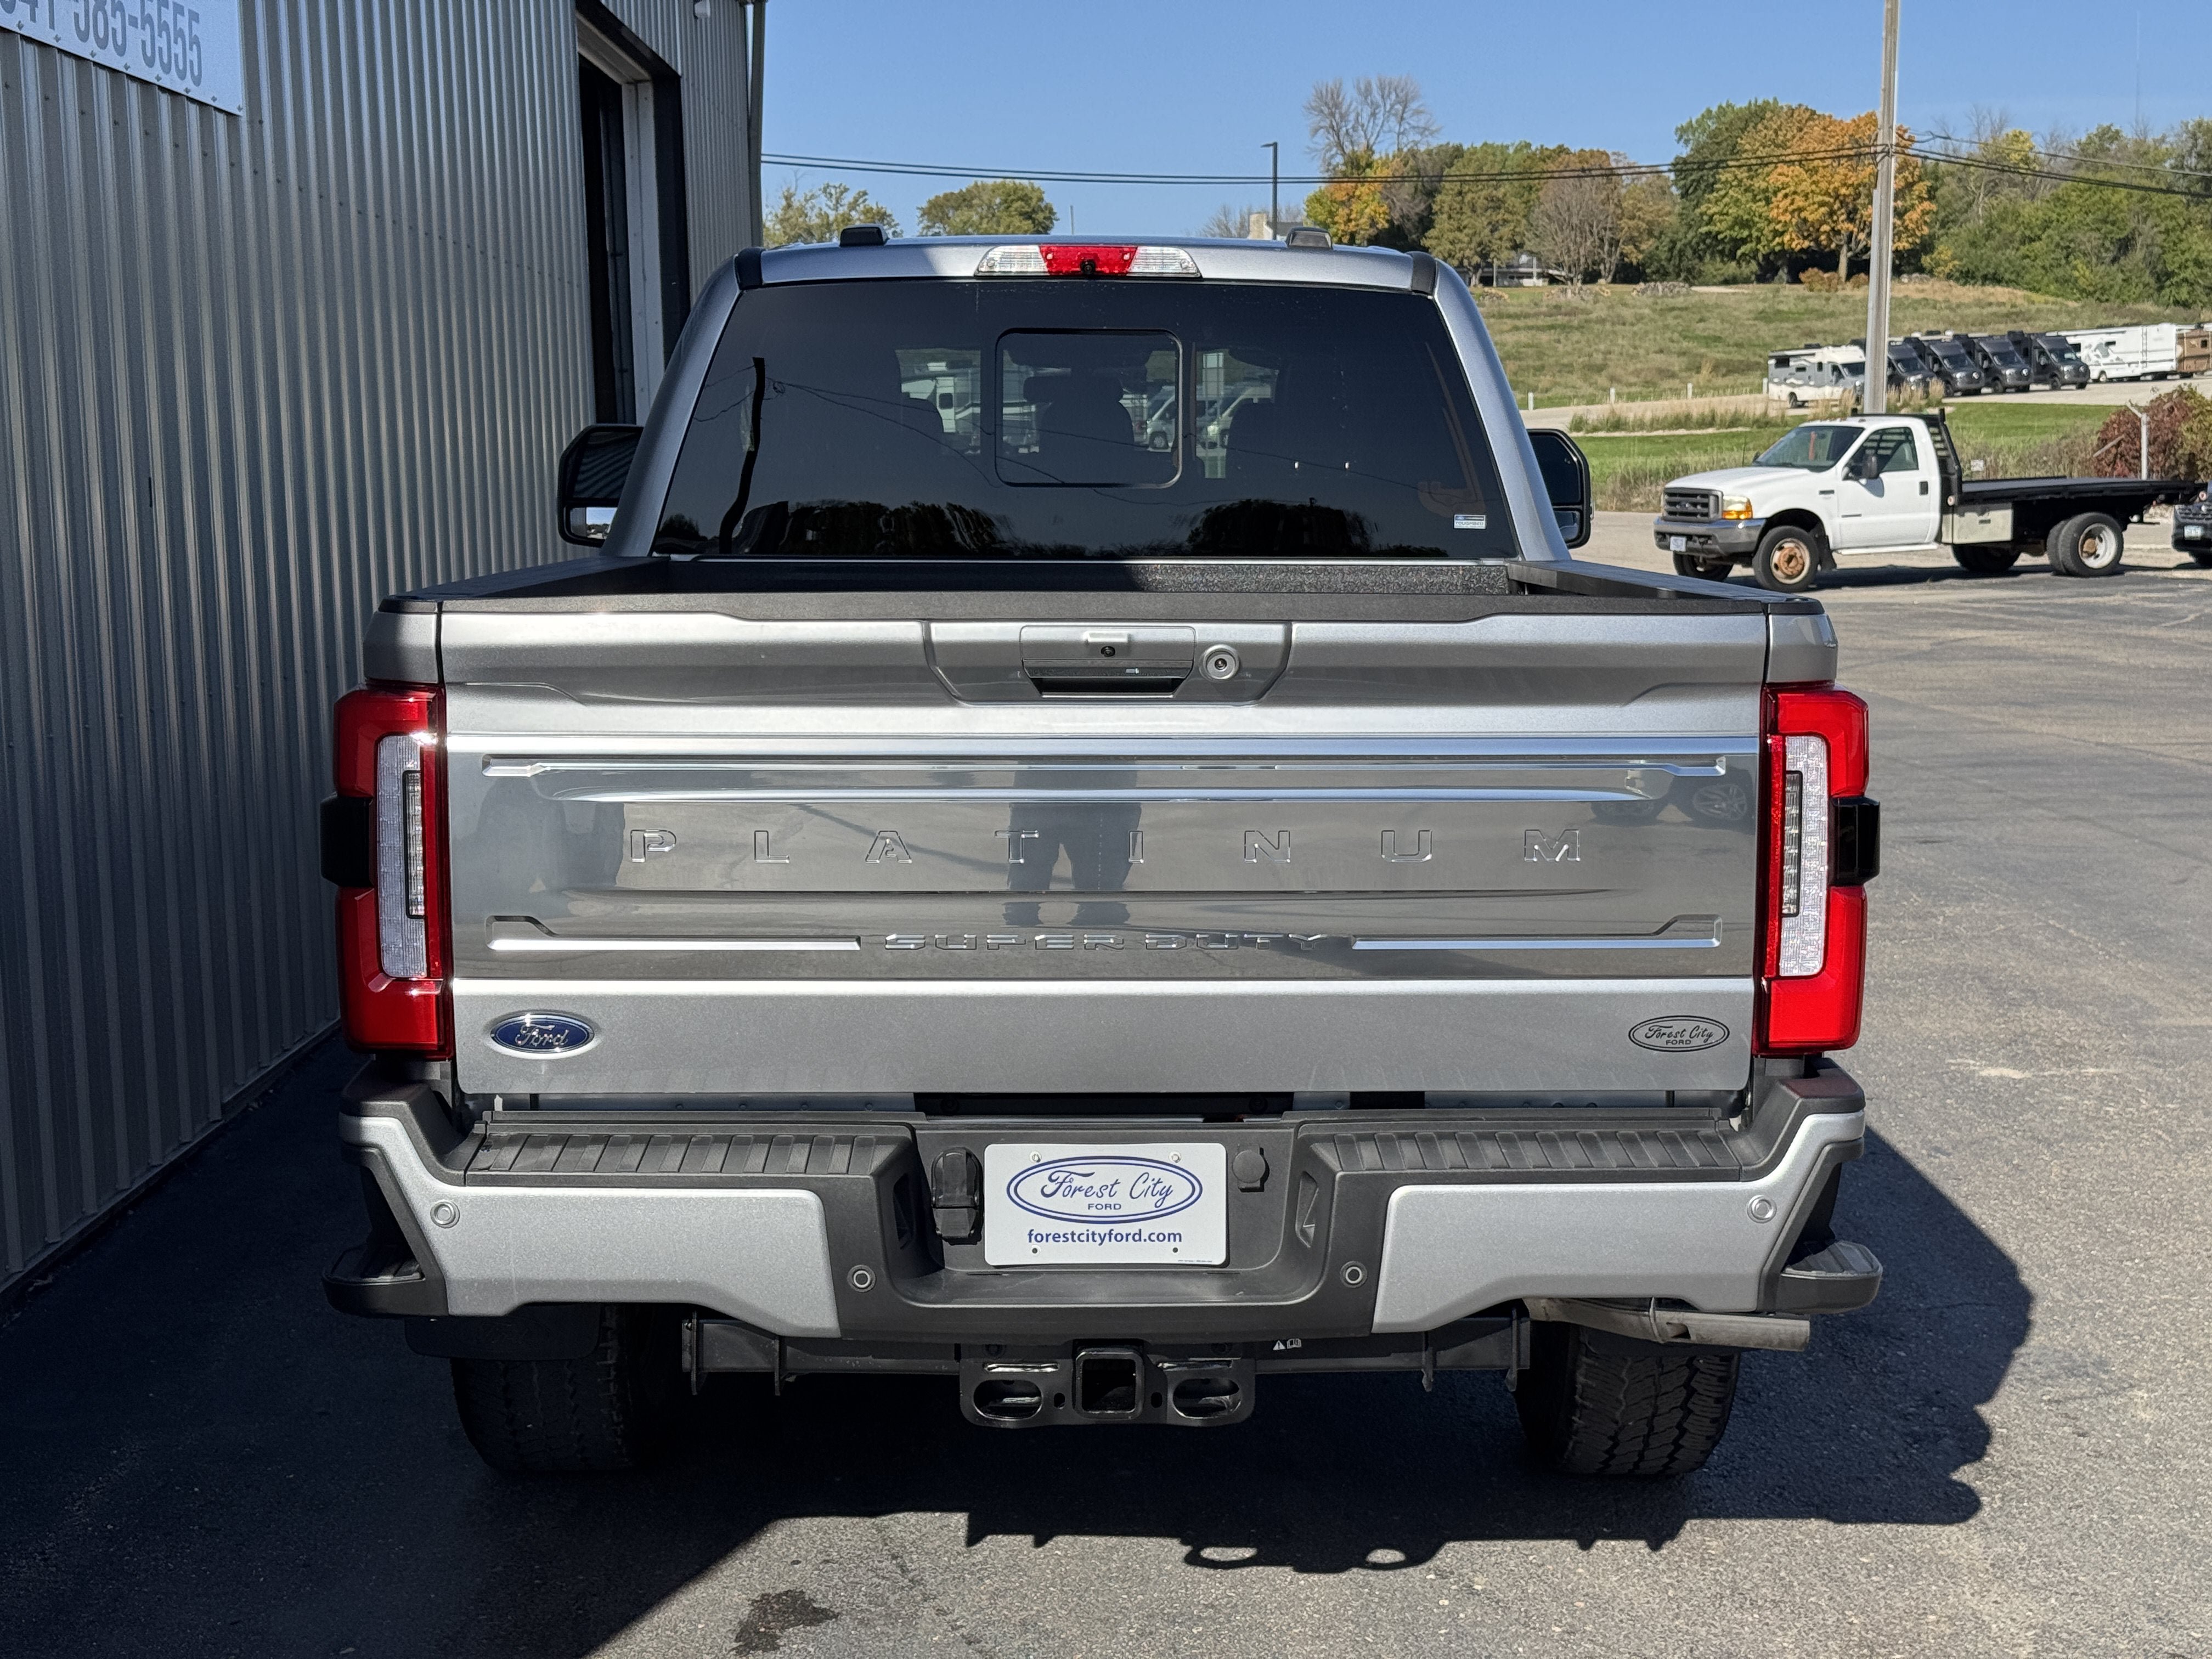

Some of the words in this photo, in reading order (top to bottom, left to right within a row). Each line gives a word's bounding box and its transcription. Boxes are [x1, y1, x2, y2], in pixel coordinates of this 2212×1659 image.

[630, 829, 1581, 863] PLATINUM
[884, 934, 1125, 951] SUPER
[1145, 934, 1328, 951] DUTY
[515, 1023, 569, 1047] Ford
[1644, 1025, 1687, 1039] Forest
[1689, 1025, 1714, 1043] City
[1040, 1170, 1121, 1199] Forest
[1129, 1172, 1174, 1209] City
[1027, 1228, 1182, 1246] forestcityford.com
